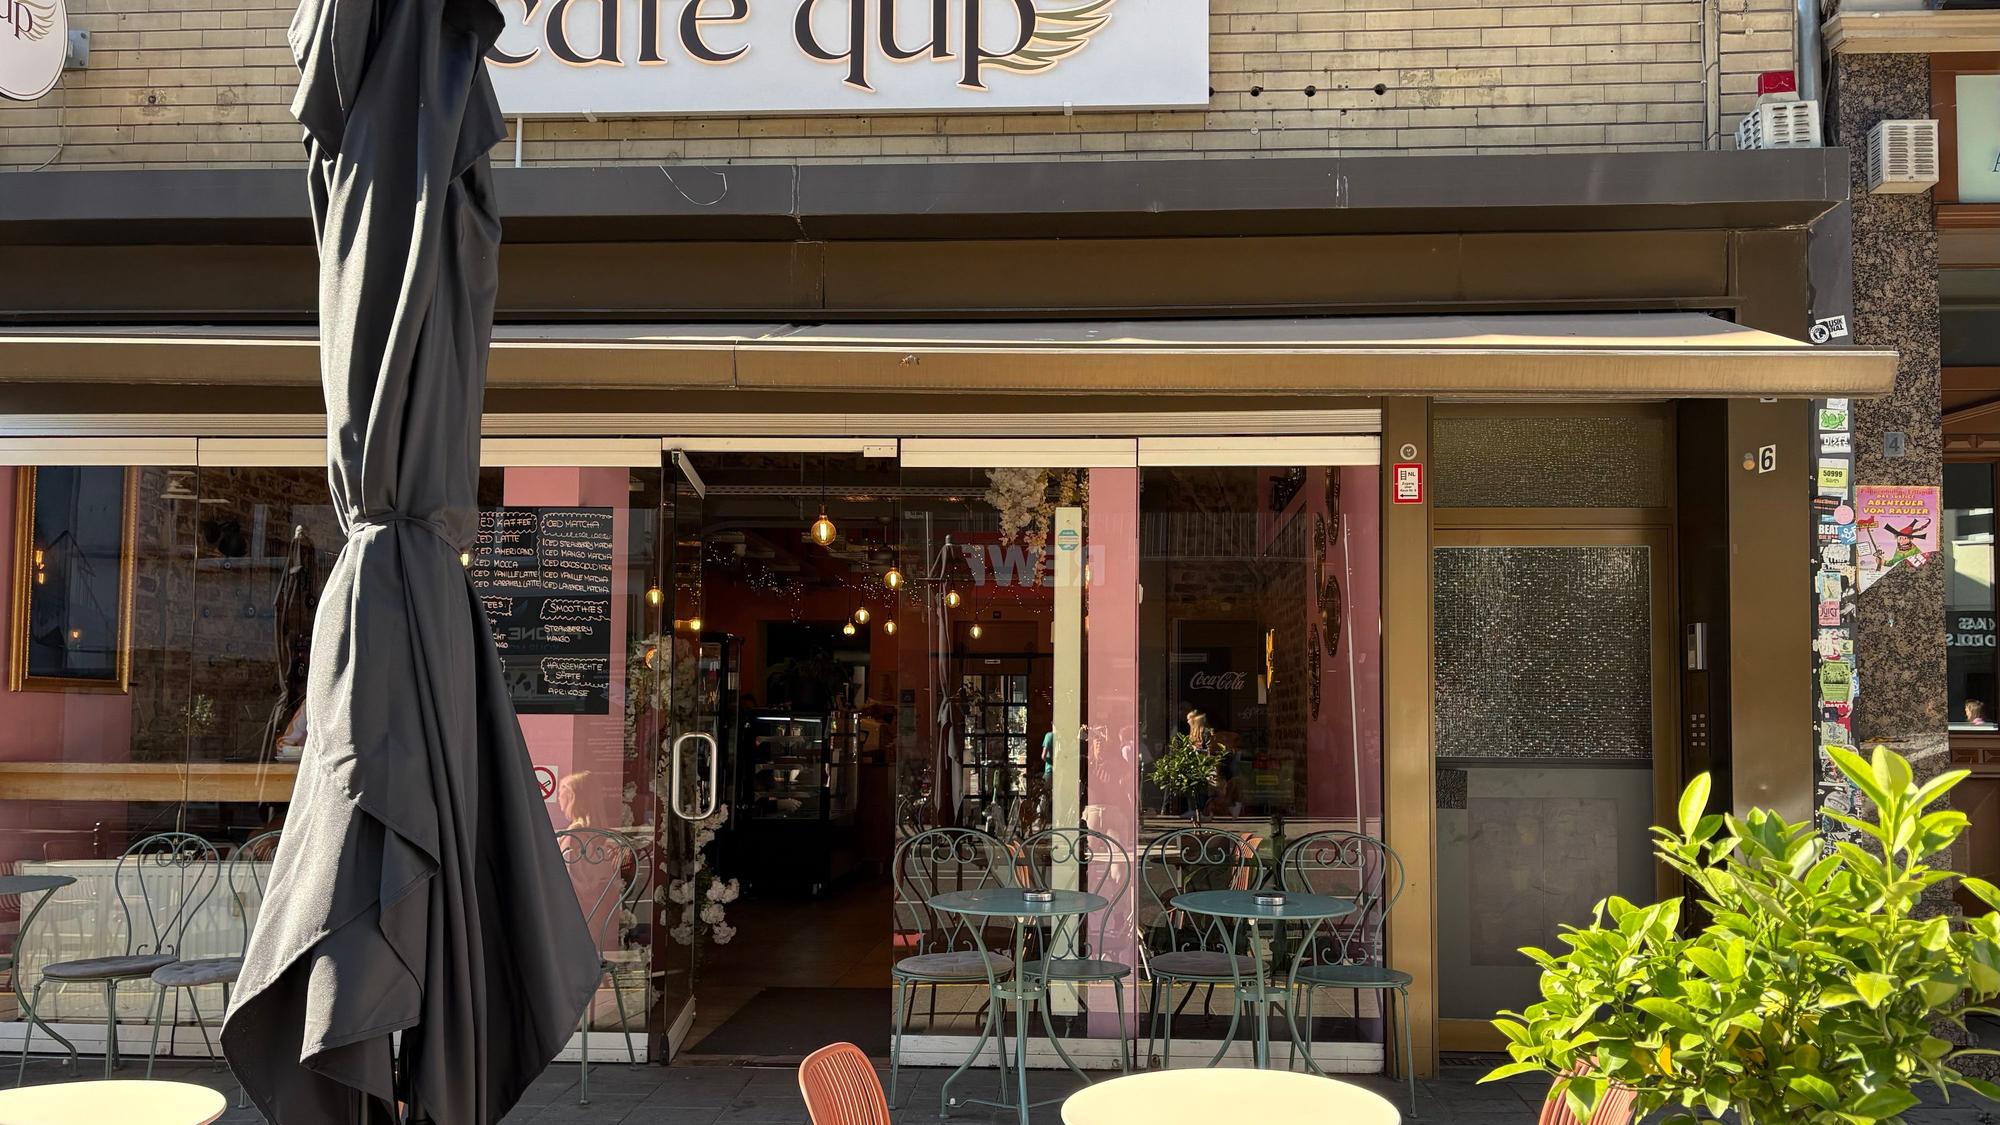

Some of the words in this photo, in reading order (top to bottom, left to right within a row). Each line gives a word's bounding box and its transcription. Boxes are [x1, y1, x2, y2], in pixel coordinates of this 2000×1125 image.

[793, 0, 1037, 92] qup
[1889, 437, 1899, 451] 4
[1761, 447, 1773, 470] 6
[1818, 524, 1838, 534] BEAT
[495, 535, 520, 543] LATTE
[561, 549, 586, 559] MANGO
[471, 569, 490, 578] ICED
